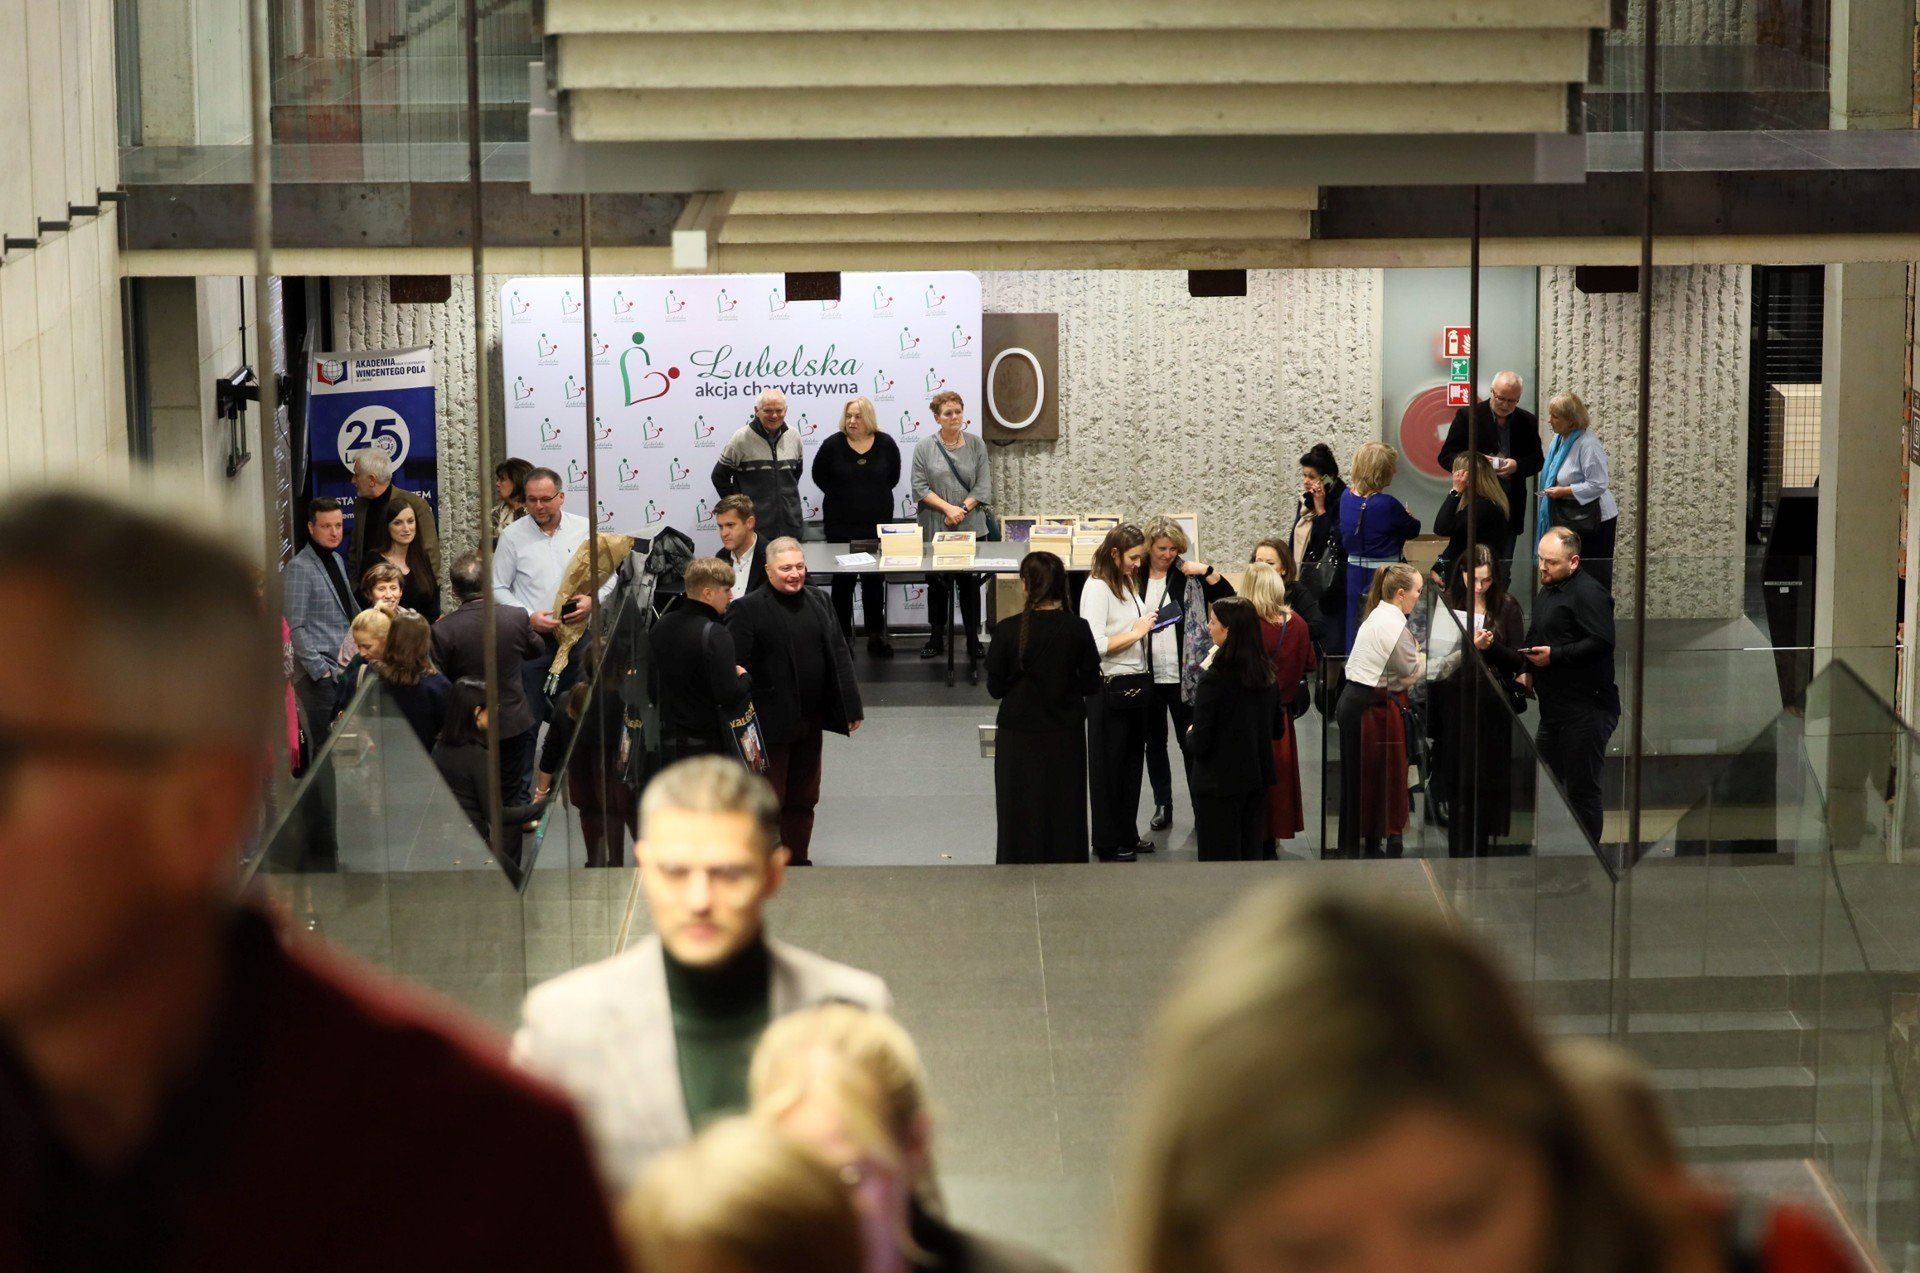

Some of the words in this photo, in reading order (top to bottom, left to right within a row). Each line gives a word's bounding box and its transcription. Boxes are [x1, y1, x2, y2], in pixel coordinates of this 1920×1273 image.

[356, 358, 396, 368] AKADEMIA
[690, 344, 863, 380] Lubelska
[356, 366, 405, 378] WINCENTEGO
[406, 366, 426, 374] POLA
[696, 382, 738, 400] akcja
[346, 418, 403, 462] 25
